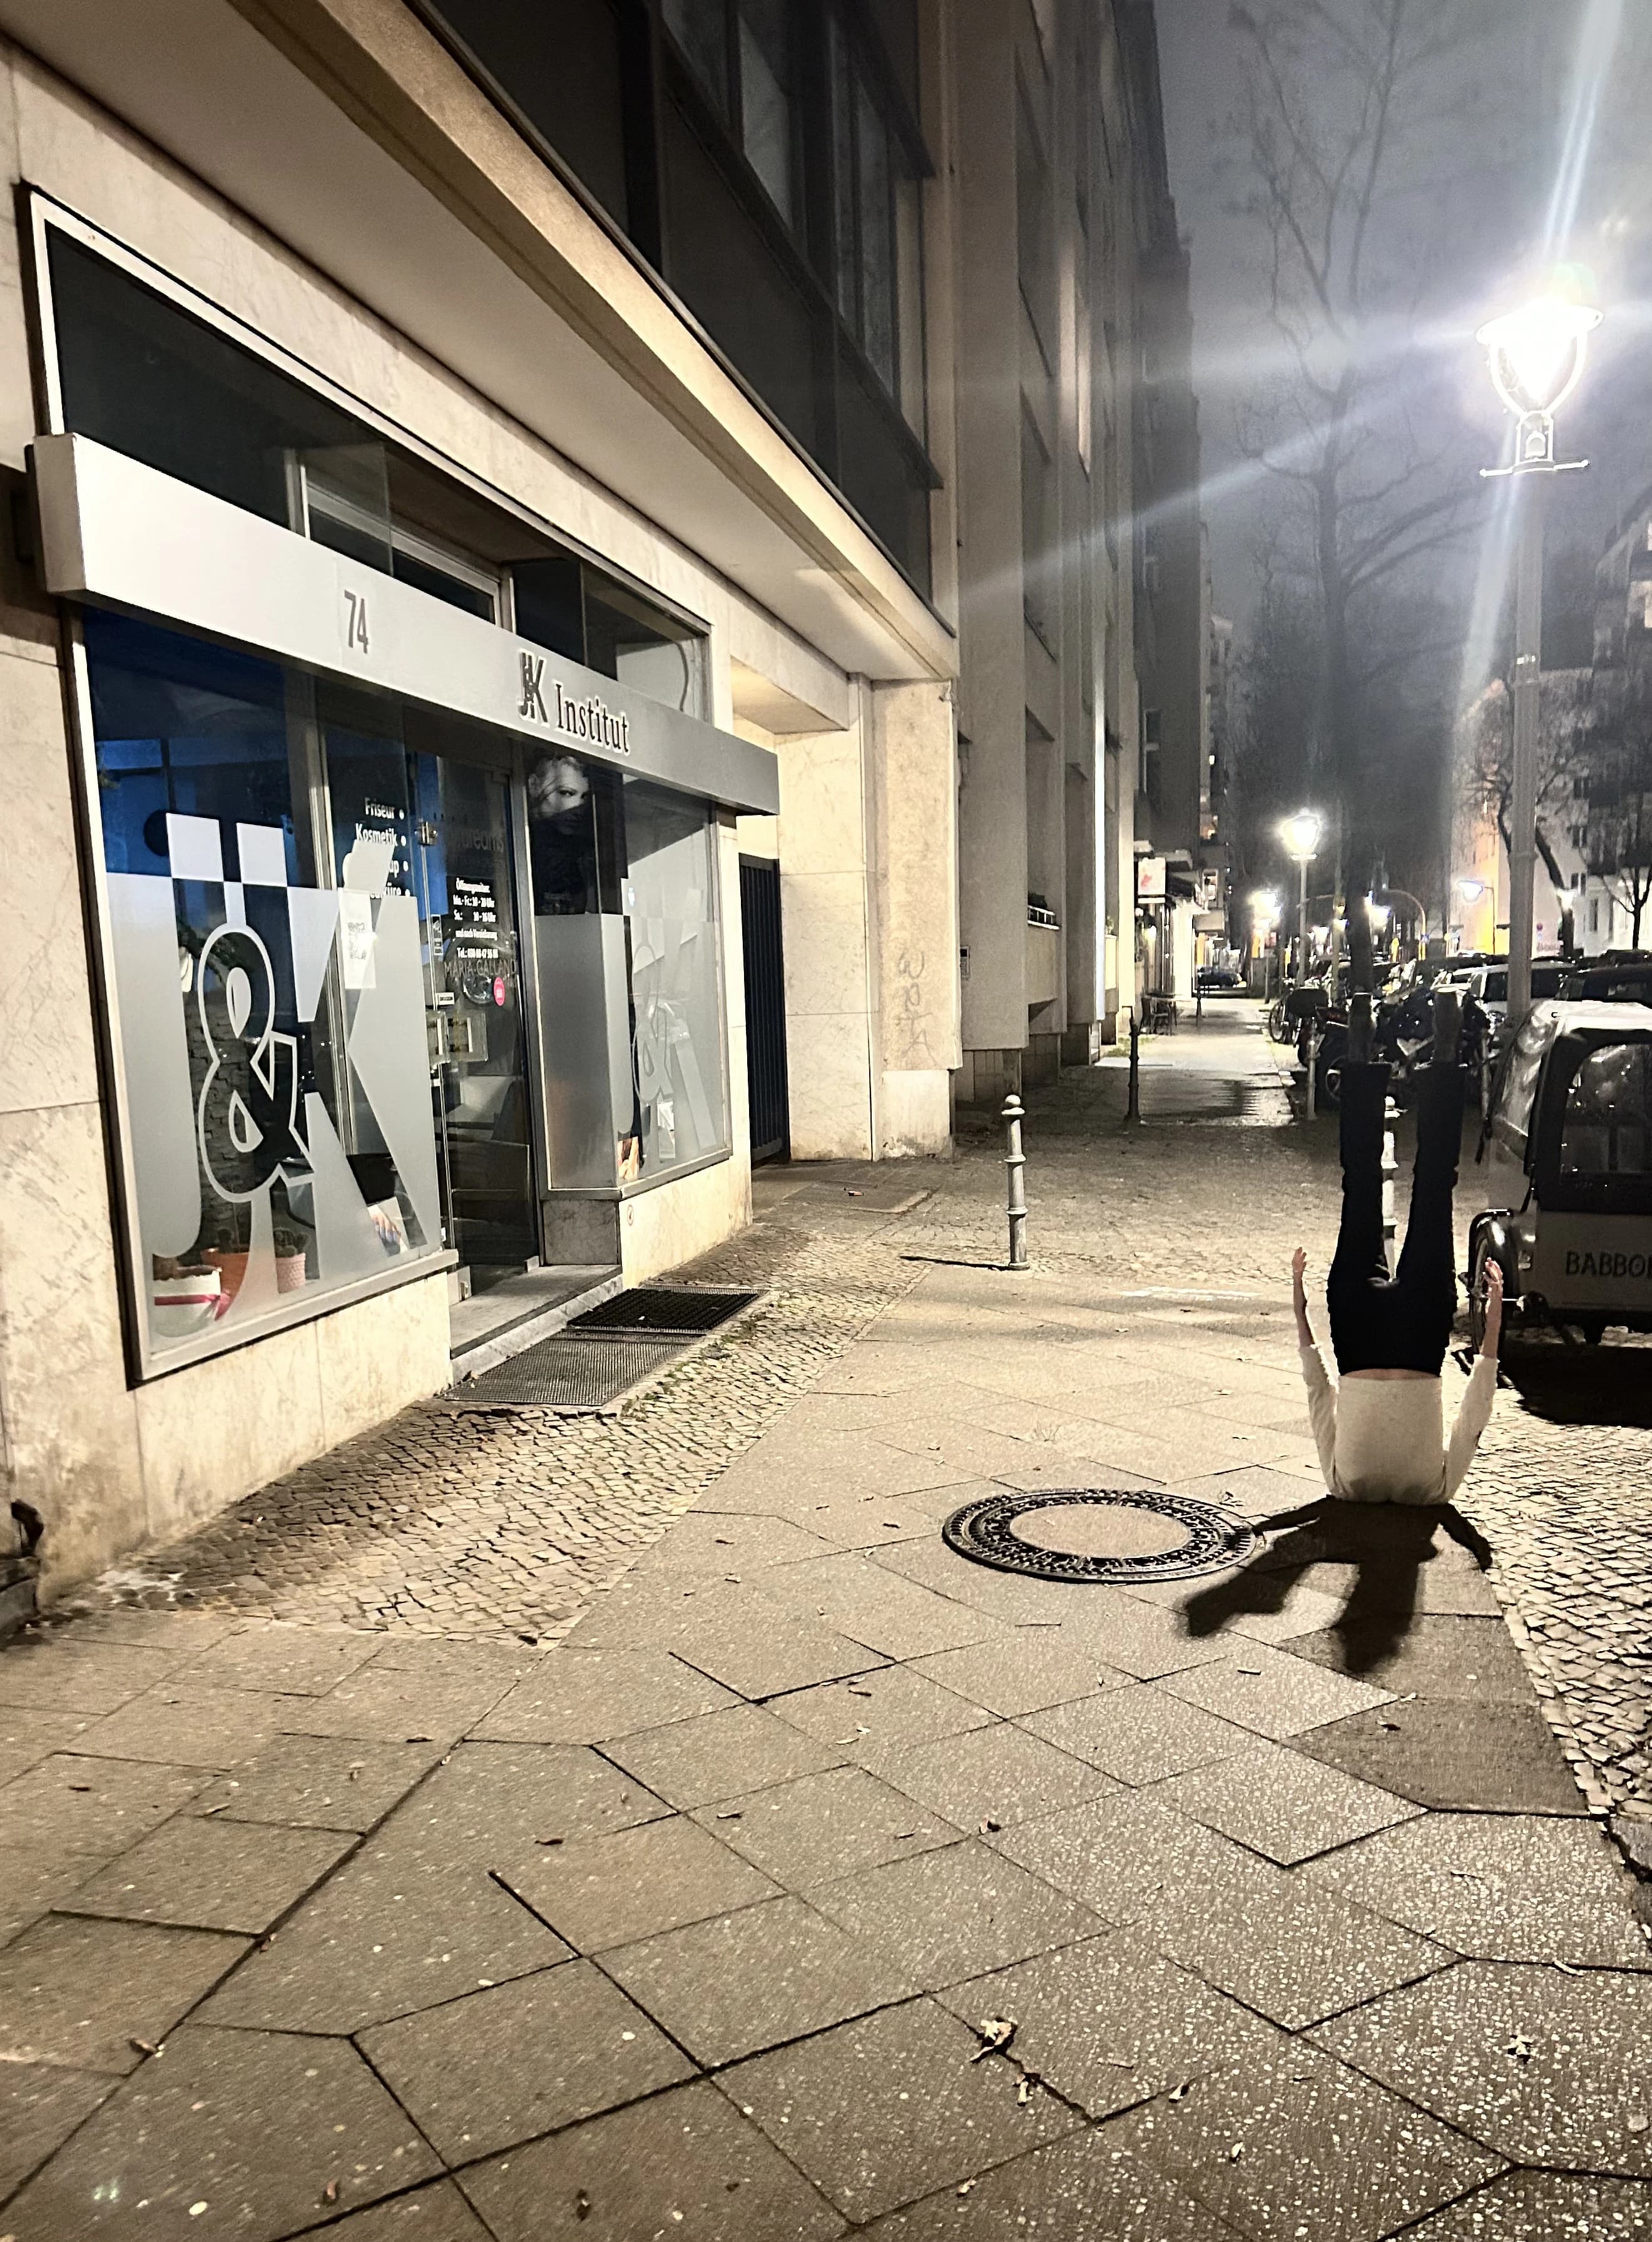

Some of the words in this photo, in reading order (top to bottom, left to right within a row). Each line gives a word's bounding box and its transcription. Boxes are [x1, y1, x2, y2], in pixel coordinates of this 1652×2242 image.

[344, 590, 368, 654] 74
[556, 683, 628, 752] Institut
[364, 797, 395, 820] Friseur
[355, 822, 398, 846] Kosmetik
